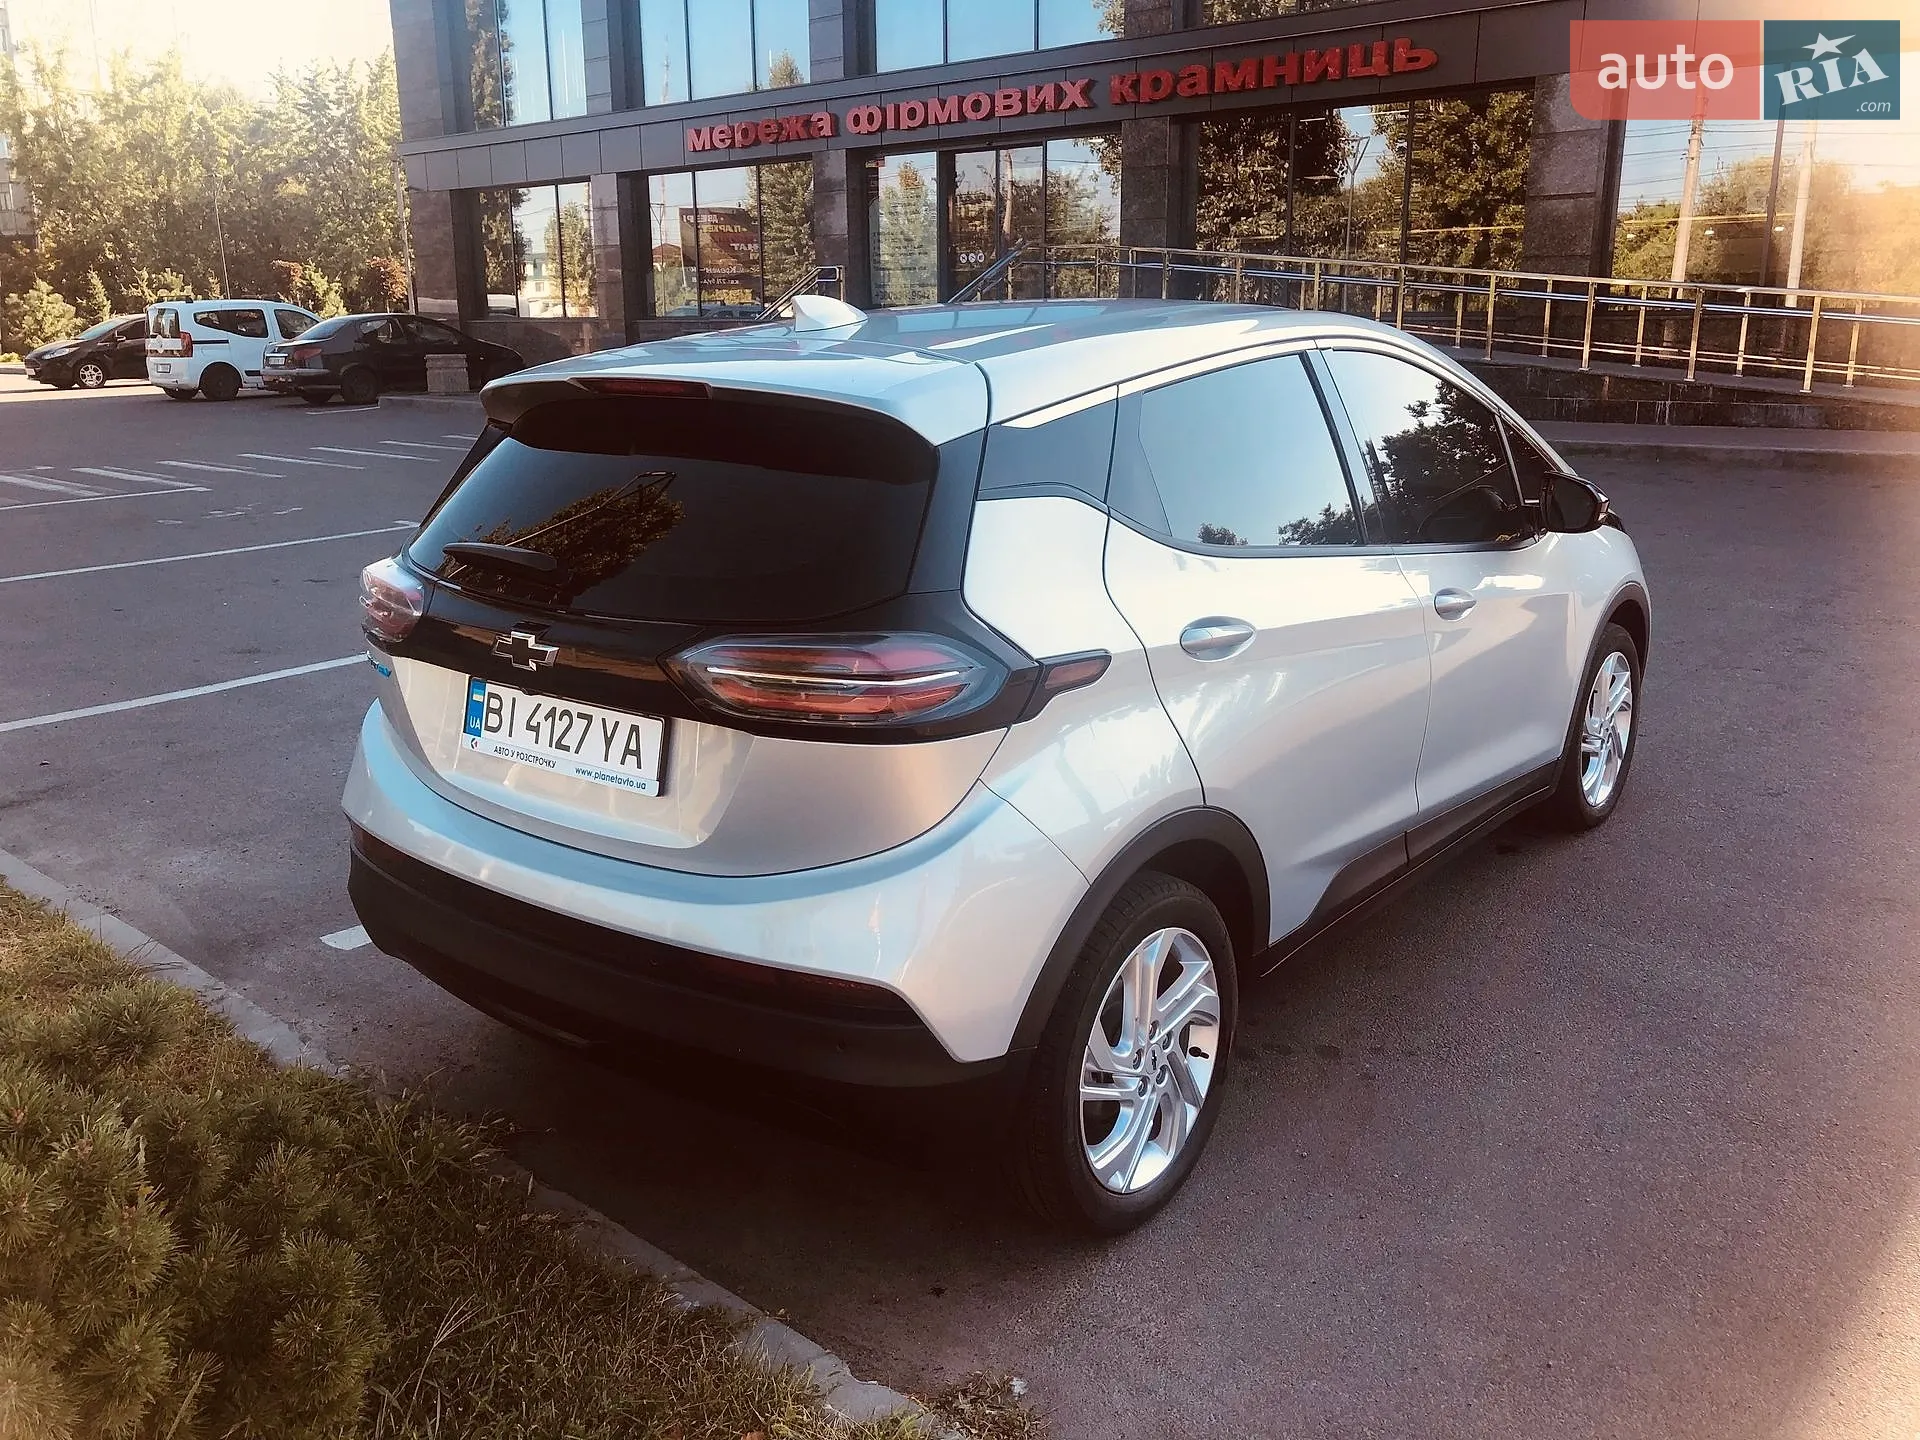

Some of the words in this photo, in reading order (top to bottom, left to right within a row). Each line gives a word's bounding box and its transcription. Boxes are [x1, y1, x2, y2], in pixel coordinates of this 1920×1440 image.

[687, 111, 834, 152] мережа
[846, 78, 1096, 135] фірмових
[1109, 37, 1440, 106] крамниць
[469, 715, 481, 730] UA
[484, 692, 517, 738] BI
[525, 703, 594, 755] 4127
[601, 717, 642, 770] YA
[493, 745, 510, 757] АВТО
[516, 751, 557, 769] РОЗСТРОЧКУ
[575, 766, 647, 790] www.planetavto.ua
